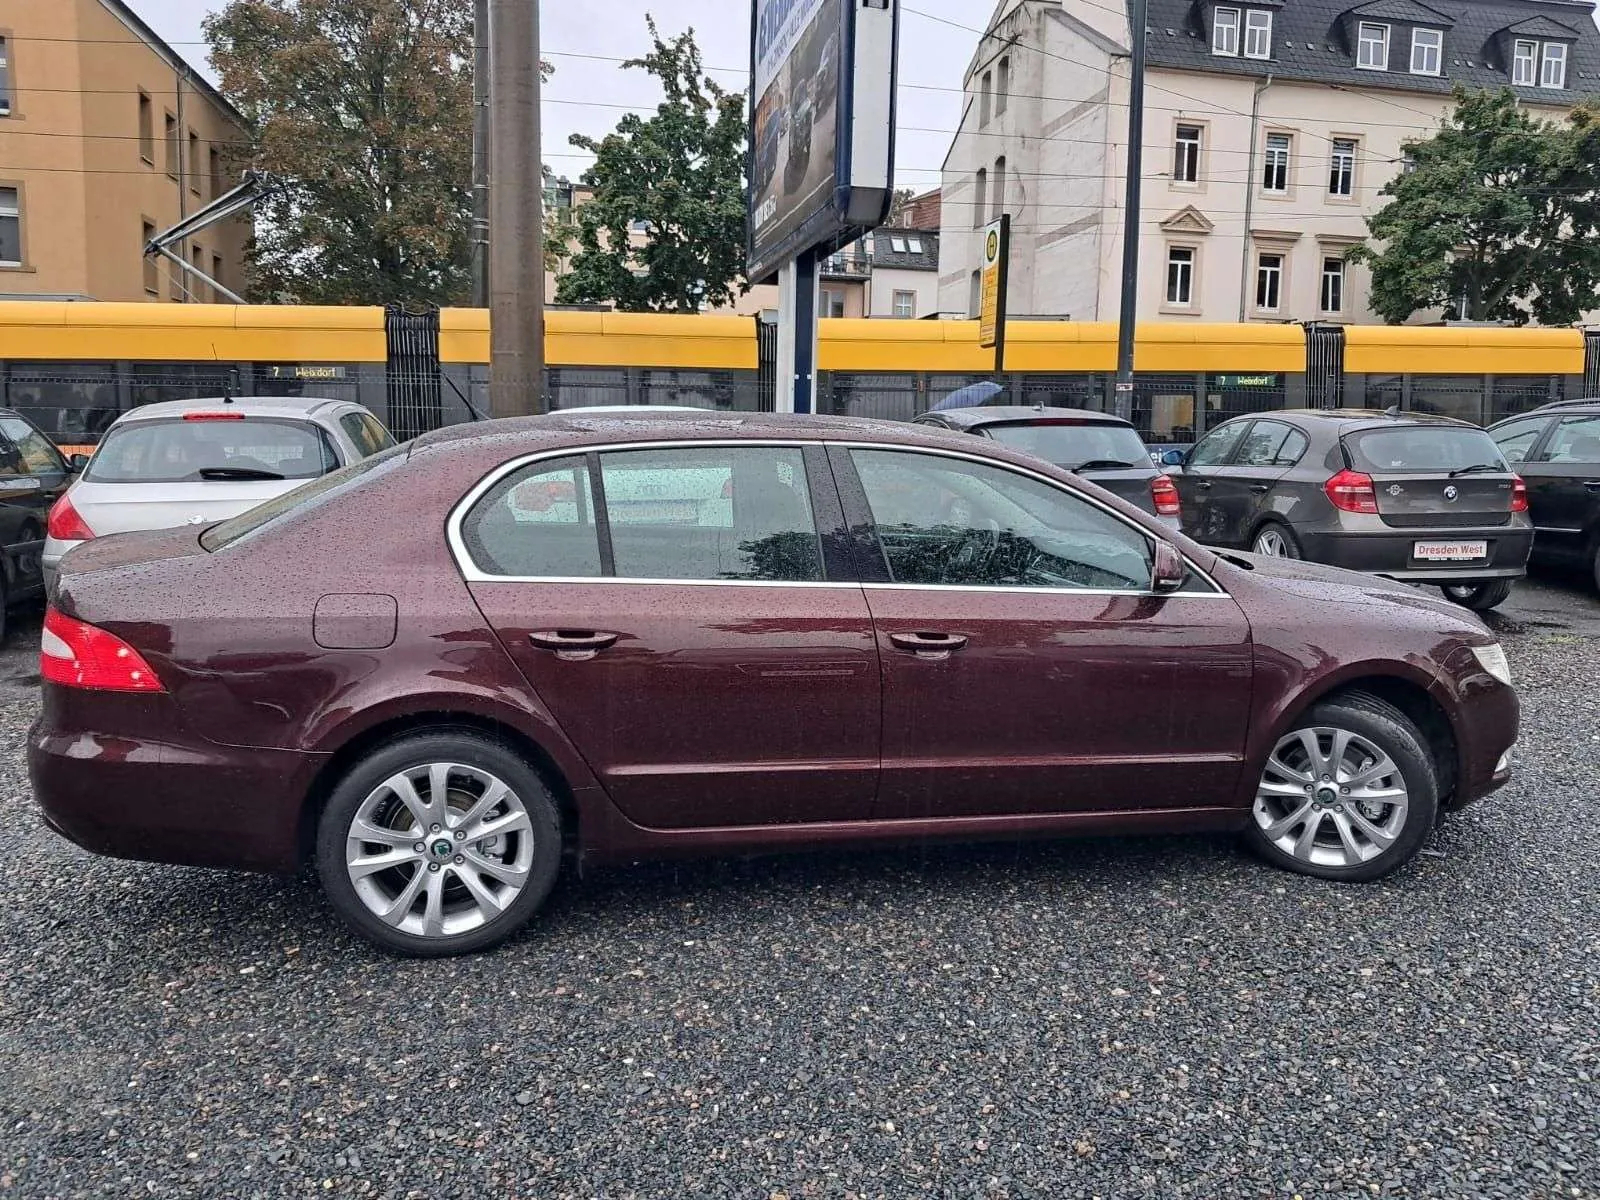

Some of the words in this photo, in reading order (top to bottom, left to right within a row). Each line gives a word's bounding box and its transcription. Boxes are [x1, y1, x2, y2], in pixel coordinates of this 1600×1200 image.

[273, 366, 279, 377] 7
[1220, 375, 1226, 385] 7
[1418, 545, 1458, 555] Dresden
[1460, 544, 1483, 554] West
